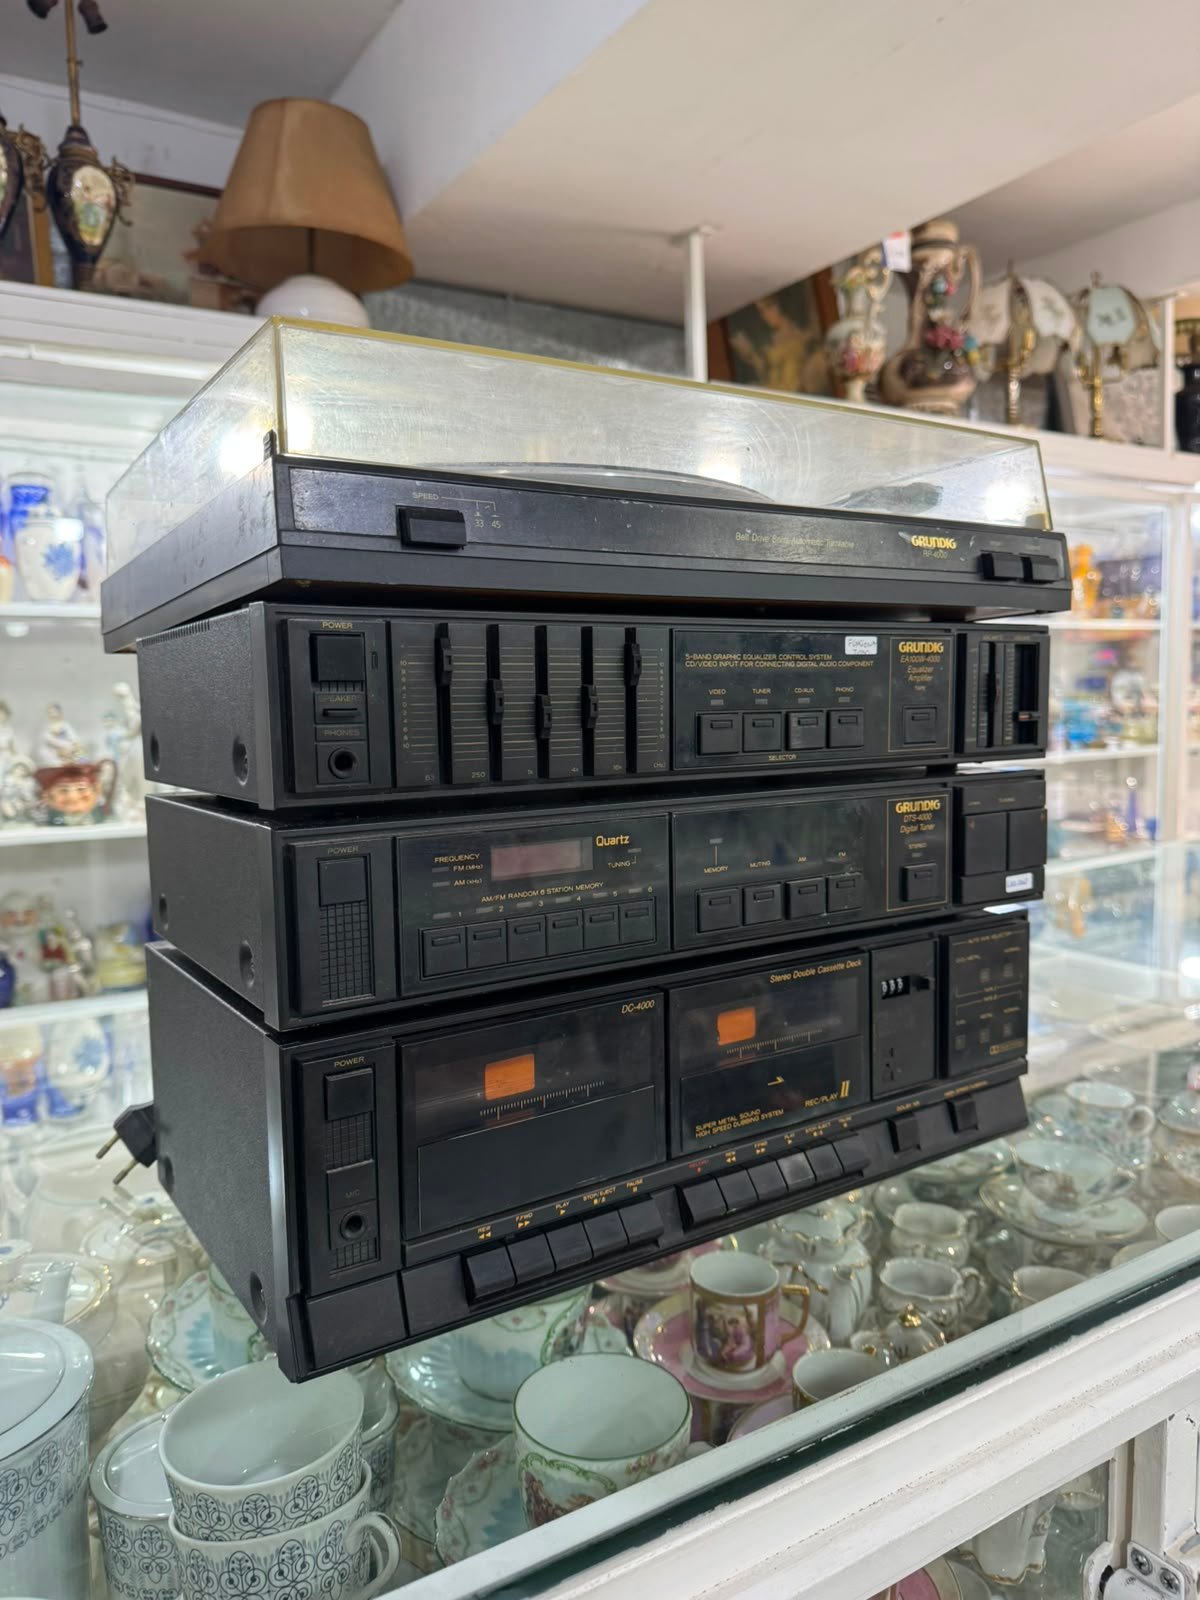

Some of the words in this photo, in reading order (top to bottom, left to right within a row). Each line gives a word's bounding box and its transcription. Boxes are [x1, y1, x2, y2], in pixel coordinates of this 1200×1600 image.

[412, 492, 439, 500] SPEED
[475, 519, 484, 528] 33
[491, 520, 502, 528] 45
[911, 535, 956, 549] GRUNDIG
[322, 621, 353, 629] POWER
[898, 641, 944, 653] GRUNDIG
[709, 688, 727, 696] VIDEO
[323, 728, 360, 737] PHONES
[471, 771, 486, 779] 250
[895, 799, 941, 814] GRUNDIG
[596, 834, 630, 847] Quartz
[327, 846, 359, 855] POWER
[434, 853, 480, 864] FREQUENCY
[749, 859, 771, 868] MUTING
[608, 860, 631, 869] TUNING
[703, 865, 729, 874] MEMORY
[481, 894, 506, 903] AM/FM
[507, 890, 540, 899] RANDOM
[546, 886, 574, 895] STATION
[575, 881, 604, 891] MEMORY
[769, 973, 791, 983] Stereo
[792, 968, 816, 979] Double
[817, 962, 845, 974] Cassette
[846, 959, 862, 969] Deck
[621, 999, 655, 1014] DC-4000
[333, 1056, 365, 1067] POWER
[804, 1092, 839, 1108] REC/PLAY
[695, 1121, 718, 1132] SUPER
[718, 1115, 738, 1126] METAL
[739, 1108, 761, 1119] SOUND
[695, 1129, 712, 1139] HIGH
[712, 1123, 732, 1134] SPEED
[733, 1116, 760, 1128] DUBBING
[761, 1108, 785, 1120] SYSTEM
[626, 1178, 644, 1188] PAUSE
[582, 1186, 617, 1202] STOP/EJECT
[555, 1200, 570, 1209] PLAY
[477, 1225, 491, 1234] REW
